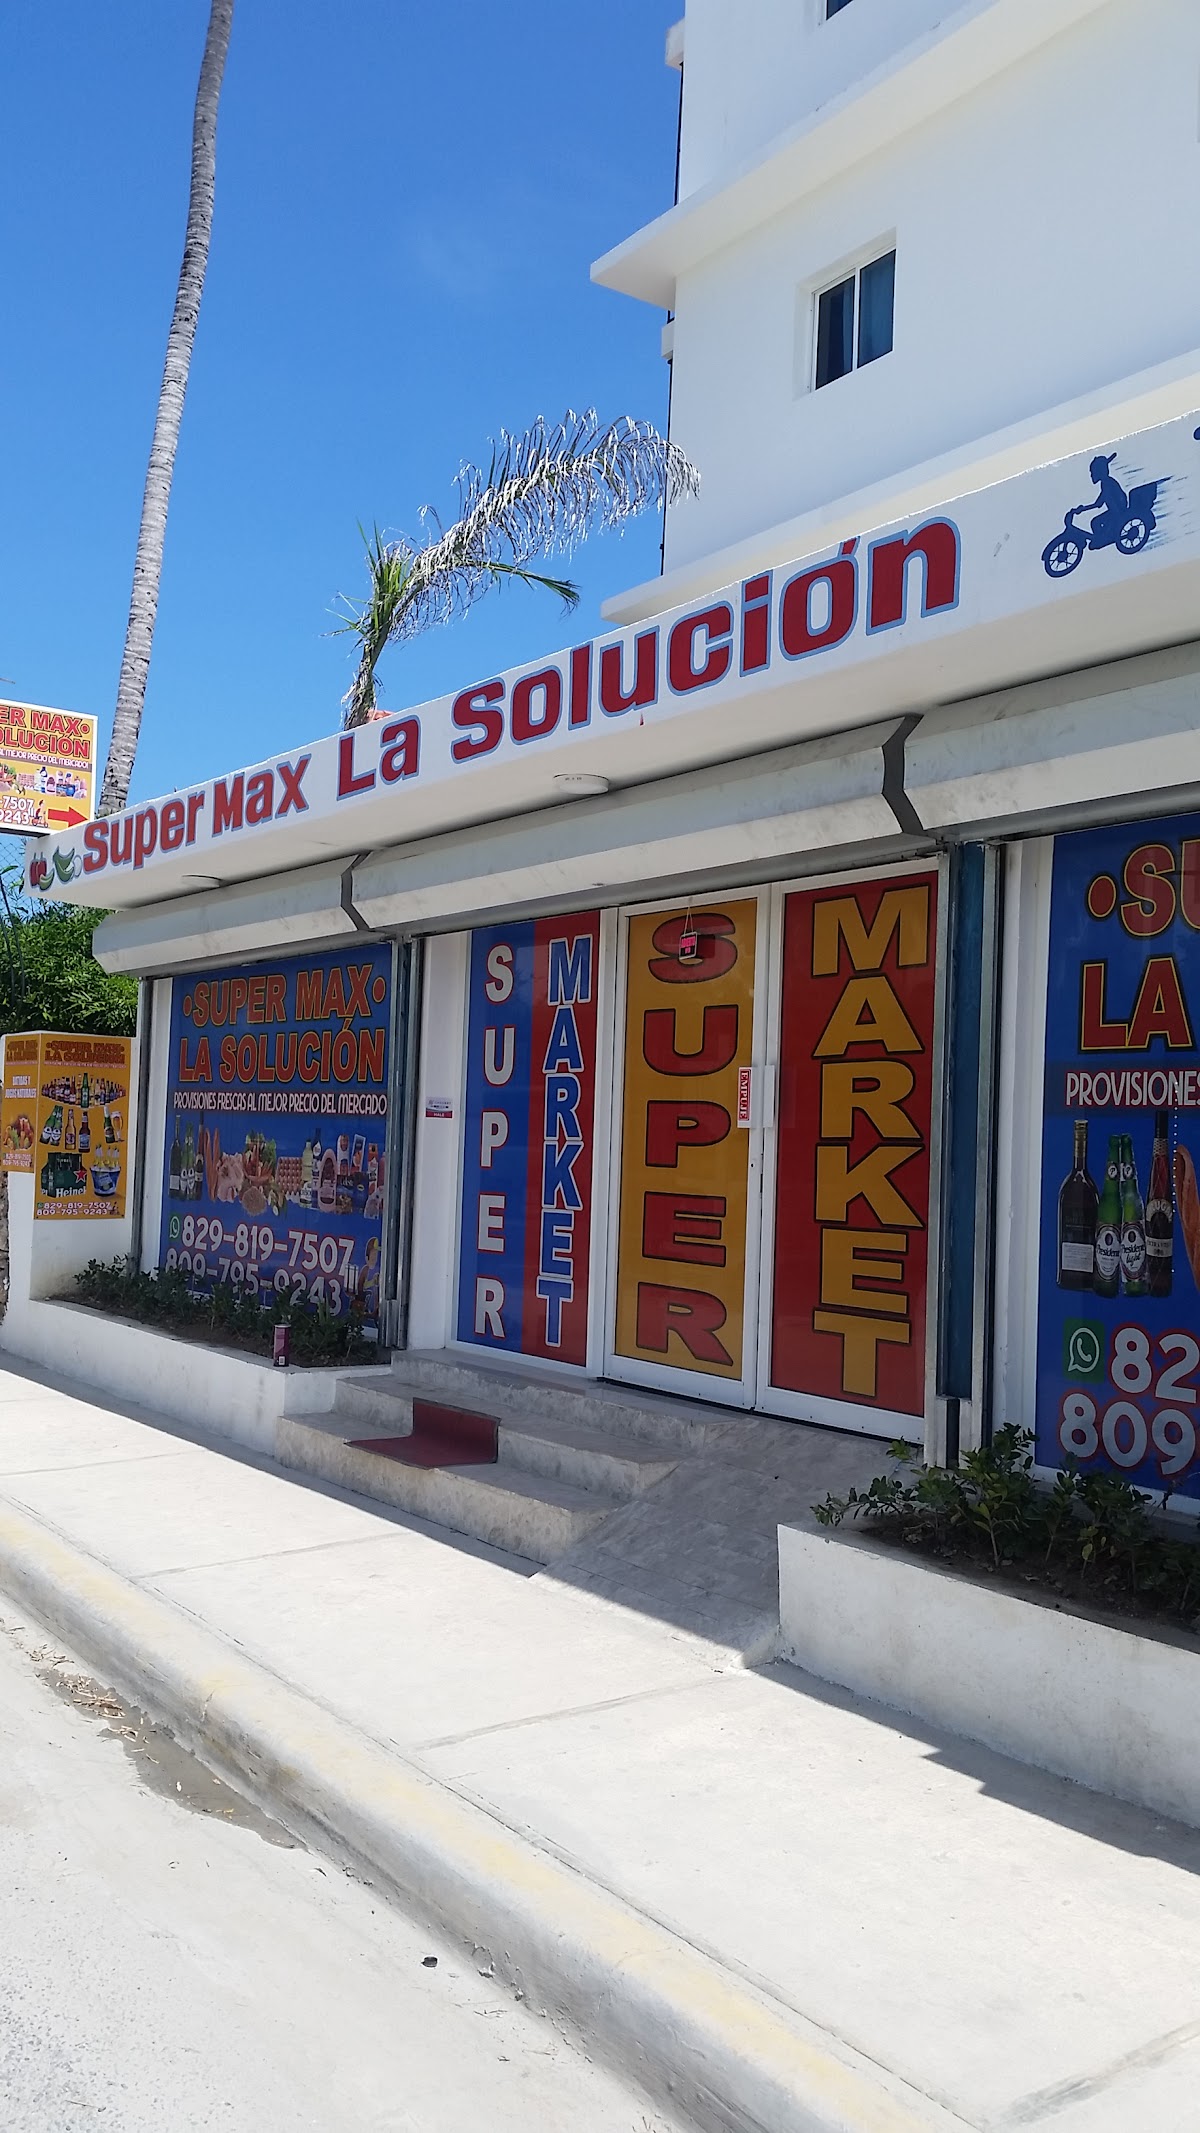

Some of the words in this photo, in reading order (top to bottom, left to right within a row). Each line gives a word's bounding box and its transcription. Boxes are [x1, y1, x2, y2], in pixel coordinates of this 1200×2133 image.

[83, 791, 204, 875] Super
[212, 753, 311, 837] Max
[336, 714, 421, 801] La
[451, 517, 962, 764] Solución
[6, 749, 26, 758] MEJOR
[28, 753, 47, 762] PRECIO
[48, 756, 58, 764] DEL
[192, 973, 287, 1027] SUPER
[295, 963, 372, 1020] MAX
[1080, 956, 1193, 1052] LA
[179, 1037, 213, 1083] LA
[219, 1018, 386, 1083] SOLUCIÓN
[174, 1091, 216, 1110] PROVISIONES
[217, 1092, 246, 1110] FRESCAS
[248, 1093, 257, 1111] AL
[258, 1093, 288, 1112] MEJOR
[289, 1093, 319, 1113] PRECIO
[321, 1093, 336, 1113] DEL
[338, 1094, 387, 1115] MERCADO
[740, 1071, 749, 1120] EMPUJE
[475, 943, 515, 1339] SUPER
[535, 933, 593, 1348] MARKET
[636, 912, 739, 1367] SUPER
[810, 883, 931, 1399] MARKET
[37, 1208, 107, 1216] 809-795-9243
[181, 1215, 355, 1276] 829-819-7507
